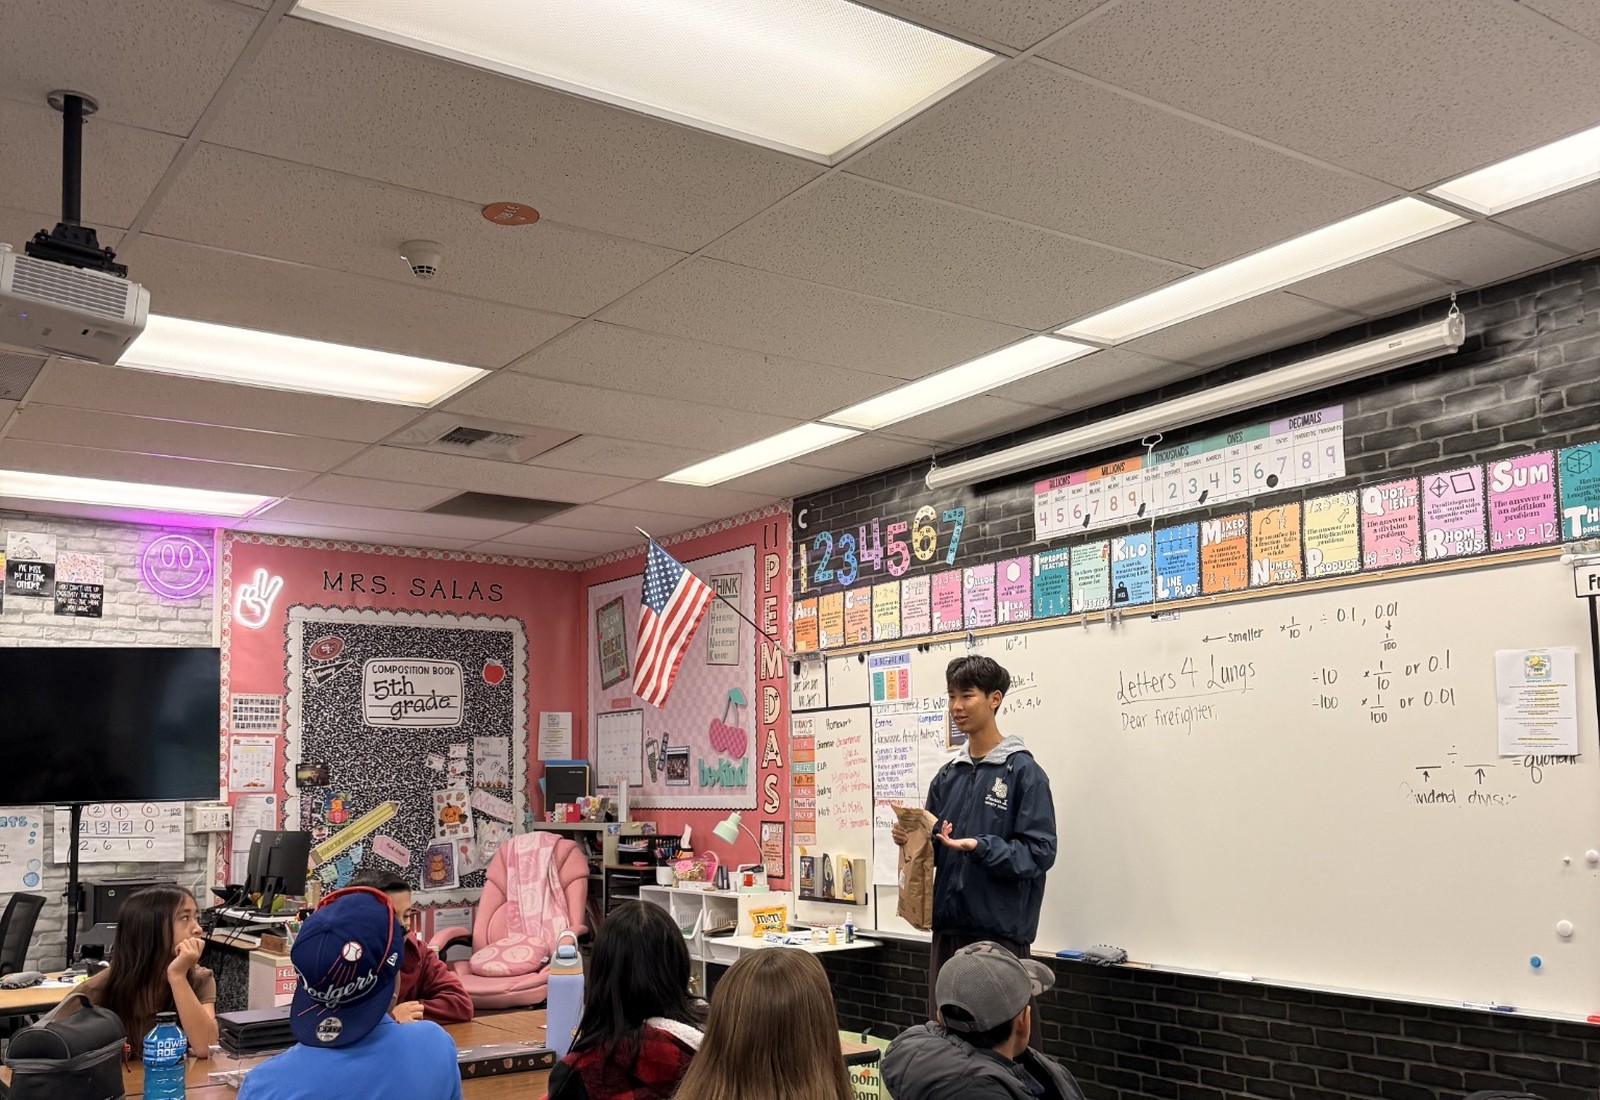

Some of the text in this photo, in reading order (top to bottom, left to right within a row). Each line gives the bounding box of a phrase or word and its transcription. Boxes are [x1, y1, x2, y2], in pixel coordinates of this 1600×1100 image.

[1289, 412, 1322, 429] DECIMALS
[1227, 432, 1243, 444] ONES
[1156, 446, 1189, 463] THOUSANDS
[1102, 463, 1126, 476] MILLIONS
[1492, 461, 1549, 493] SUM
[1040, 512, 1048, 526] 4
[1057, 508, 1065, 523] 5
[1074, 504, 1082, 519] 6
[1092, 500, 1100, 516] 7
[1110, 496, 1118, 512] 8
[1129, 491, 1137, 507] 9
[1168, 483, 1178, 499] 2
[1189, 478, 1198, 494] 3
[1210, 472, 1220, 489] 4
[1233, 467, 1242, 484] 5
[1254, 462, 1264, 480] 6
[1277, 456, 1287, 475] 7
[1302, 452, 1312, 469] 8
[1326, 446, 1336, 464] 9
[1050, 476, 1071, 489] BILLIONS
[1390, 496, 1417, 511] IENT
[1432, 498, 1475, 509] Parallelogram
[1508, 495, 1541, 506] answer
[1511, 502, 1546, 513] addition
[798, 509, 808, 529] C
[1379, 517, 1407, 526] answer
[1504, 511, 1540, 523] problem
[1201, 518, 1245, 547] MIXED
[1308, 529, 1354, 541] multiplication
[1319, 526, 1342, 534] answer
[1379, 523, 1408, 533] division
[1494, 531, 1504, 544] 4
[1516, 527, 1526, 541] 8
[1539, 523, 1555, 539] 12
[1317, 537, 1345, 547] problem
[1375, 531, 1406, 542] problem
[800, 505, 966, 593] 1 2 3 4 5 6 7
[1111, 537, 1148, 563] KILO
[1394, 547, 1402, 561] 8
[1414, 545, 1422, 557] 6
[1456, 540, 1482, 554] BUS
[1034, 552, 1069, 577] IMPROPER
[1041, 560, 1069, 570] FRACTION
[1306, 548, 1359, 576] PRODUCT
[1274, 569, 1297, 581] ATOR
[323, 570, 504, 602] MRS. SALAS
[712, 578, 738, 595] THINK
[1157, 575, 1182, 599] LINE
[1175, 583, 1200, 597] PLOT
[1072, 588, 1110, 613] JUSTIFY
[794, 602, 817, 620] AREA
[932, 612, 963, 632] FACTOR
[1228, 628, 1264, 643] smaller
[1375, 602, 1398, 619] 0.01
[1406, 663, 1421, 676] or
[1429, 649, 1450, 672] 0.1
[372, 665, 455, 676] COMPOSITION BOOK
[1180, 657, 1198, 687] 4
[1207, 654, 1256, 693] Lungs
[374, 675, 415, 700] 5th
[390, 690, 451, 721] grade
[923, 698, 930, 710] 5
[1400, 697, 1415, 709] or
[1424, 688, 1455, 706] 0.01
[826, 718, 853, 731] Homework
[1122, 712, 1148, 731] Dear
[93, 806, 153, 817] 2 9 0
[100, 822, 109, 832] 3
[122, 822, 130, 832] 2
[145, 819, 154, 833] 0
[103, 840, 112, 851] 6
[146, 839, 154, 849] 0
[157, 1048, 176, 1057] ADE
